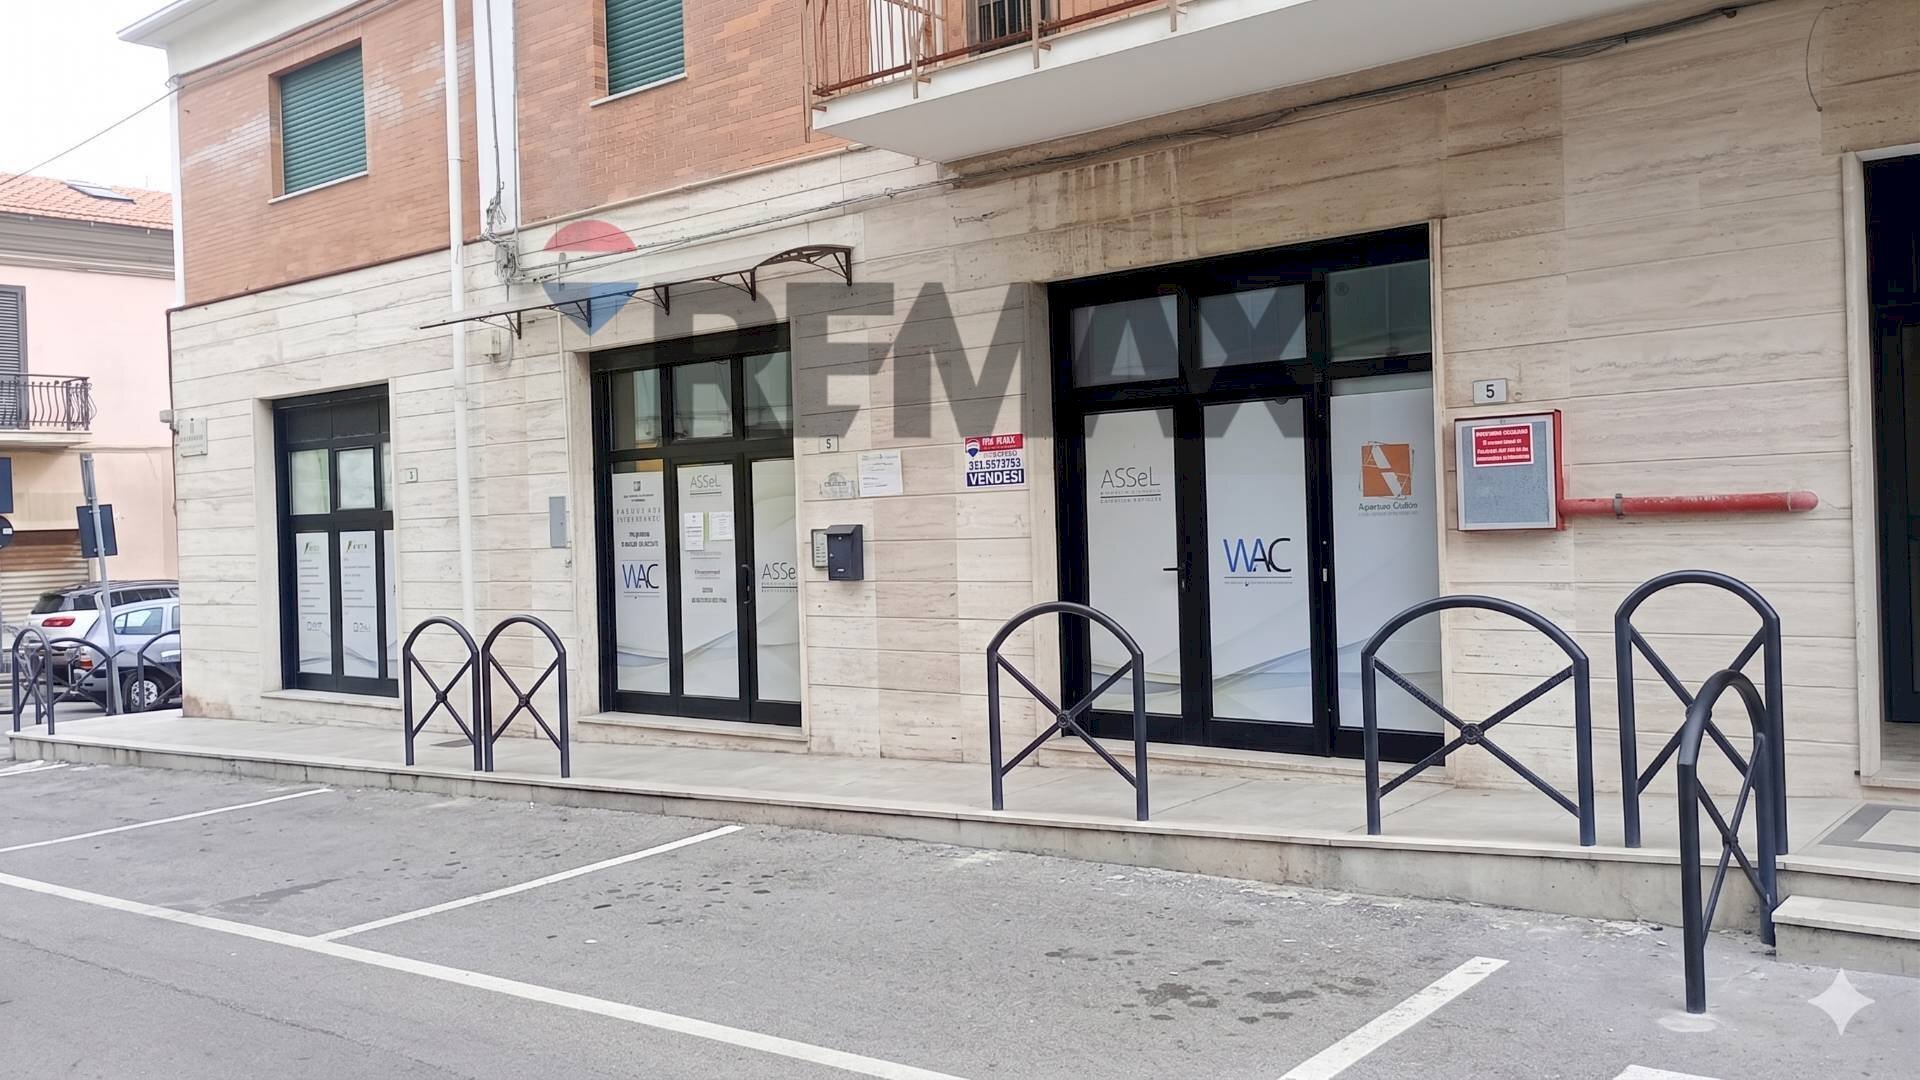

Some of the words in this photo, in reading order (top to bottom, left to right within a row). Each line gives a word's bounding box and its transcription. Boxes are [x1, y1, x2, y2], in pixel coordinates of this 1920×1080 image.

[1486, 384, 1495, 398] 5
[969, 470, 1022, 485] VENDESI
[1101, 466, 1161, 488] ASSeL
[1223, 538, 1292, 572] WAC
[622, 563, 659, 589] WAC
